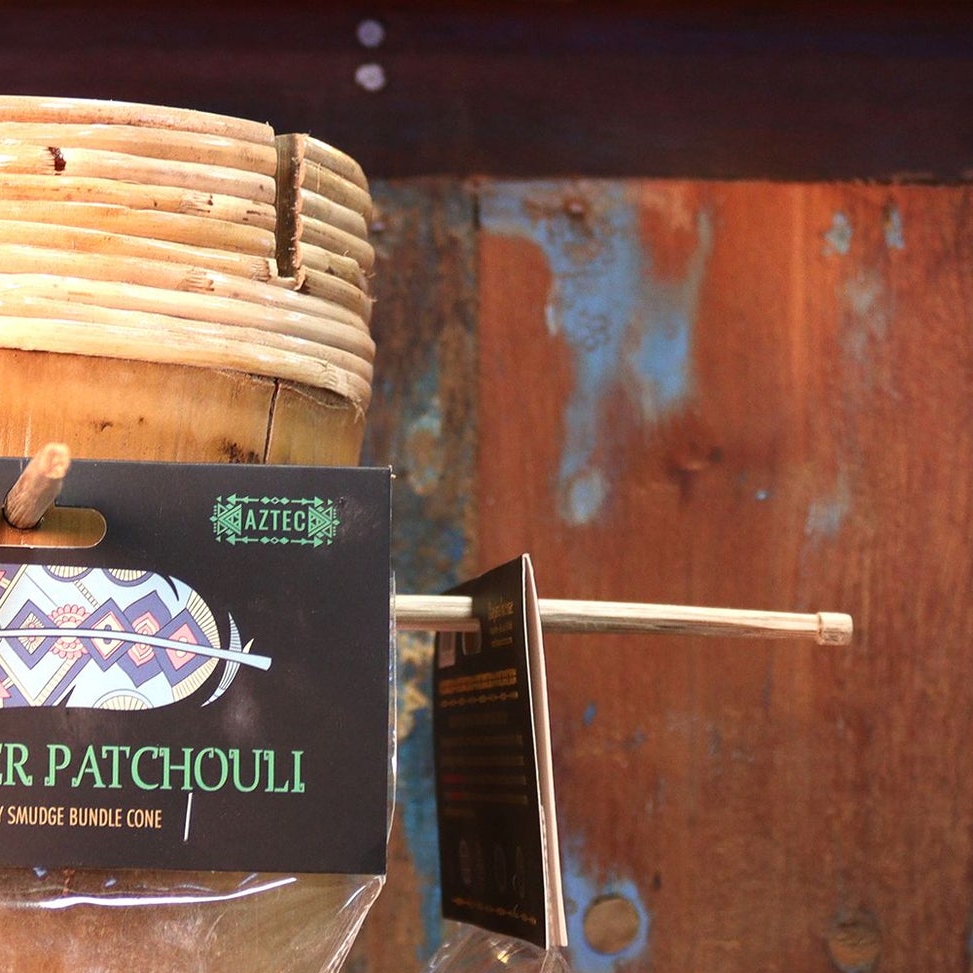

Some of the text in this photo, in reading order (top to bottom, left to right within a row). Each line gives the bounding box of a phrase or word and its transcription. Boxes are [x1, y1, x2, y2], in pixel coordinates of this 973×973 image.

[244, 508, 306, 531] AZTEC
[44, 743, 306, 793] PATCHOULI
[7, 805, 64, 826] SMUDGE
[69, 806, 123, 828] BUNDLE
[127, 808, 163, 829] CONE
